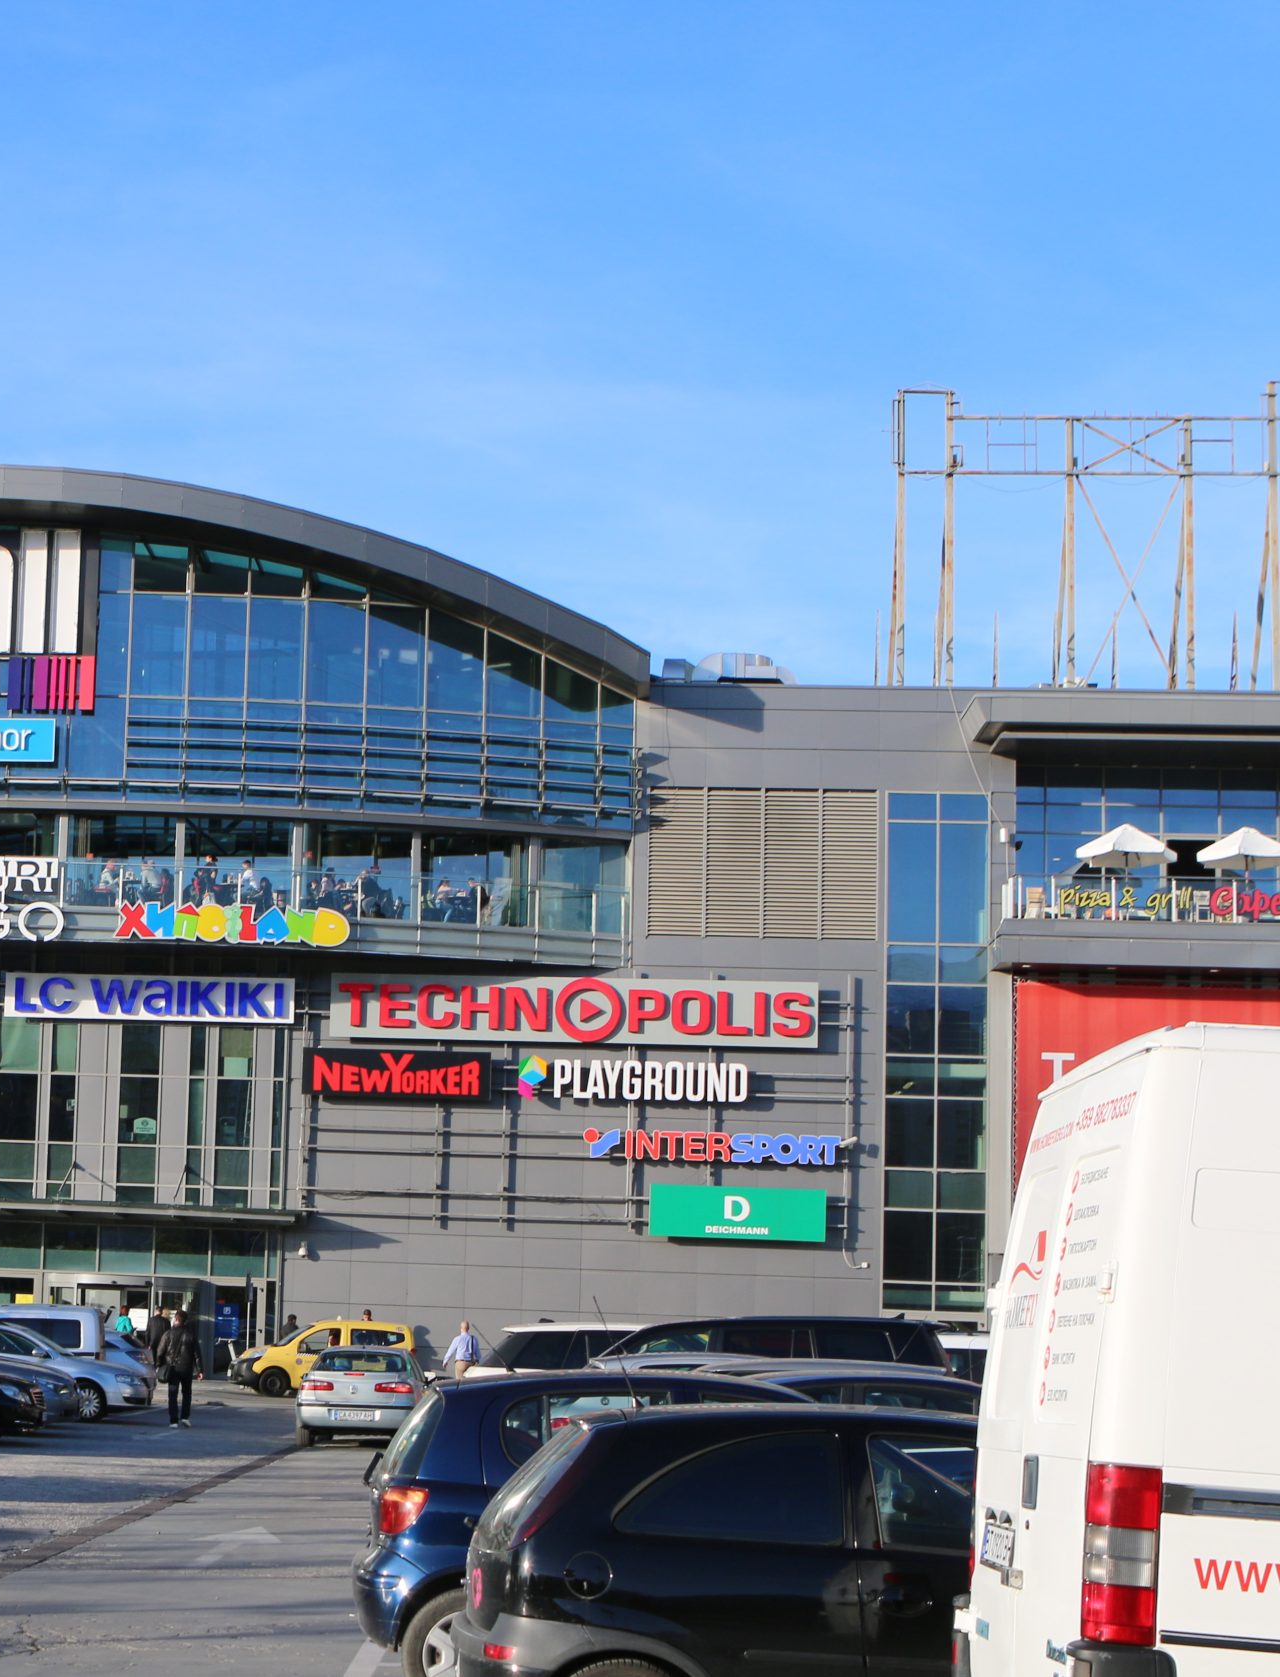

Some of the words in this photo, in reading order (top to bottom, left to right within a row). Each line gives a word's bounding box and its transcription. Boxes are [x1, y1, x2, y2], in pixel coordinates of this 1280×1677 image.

[1059, 885, 1111, 914] pizza
[1119, 886, 1137, 908] &
[1144, 886, 1192, 915] grll
[13, 976, 79, 1015] LC
[338, 976, 813, 1043] TECHNOPOLIS
[553, 1059, 748, 1103] PLAYGROUND
[624, 1128, 842, 1166] INTERSPORT
[724, 1195, 750, 1222] D
[705, 1225, 768, 1236] DEICHMANN
